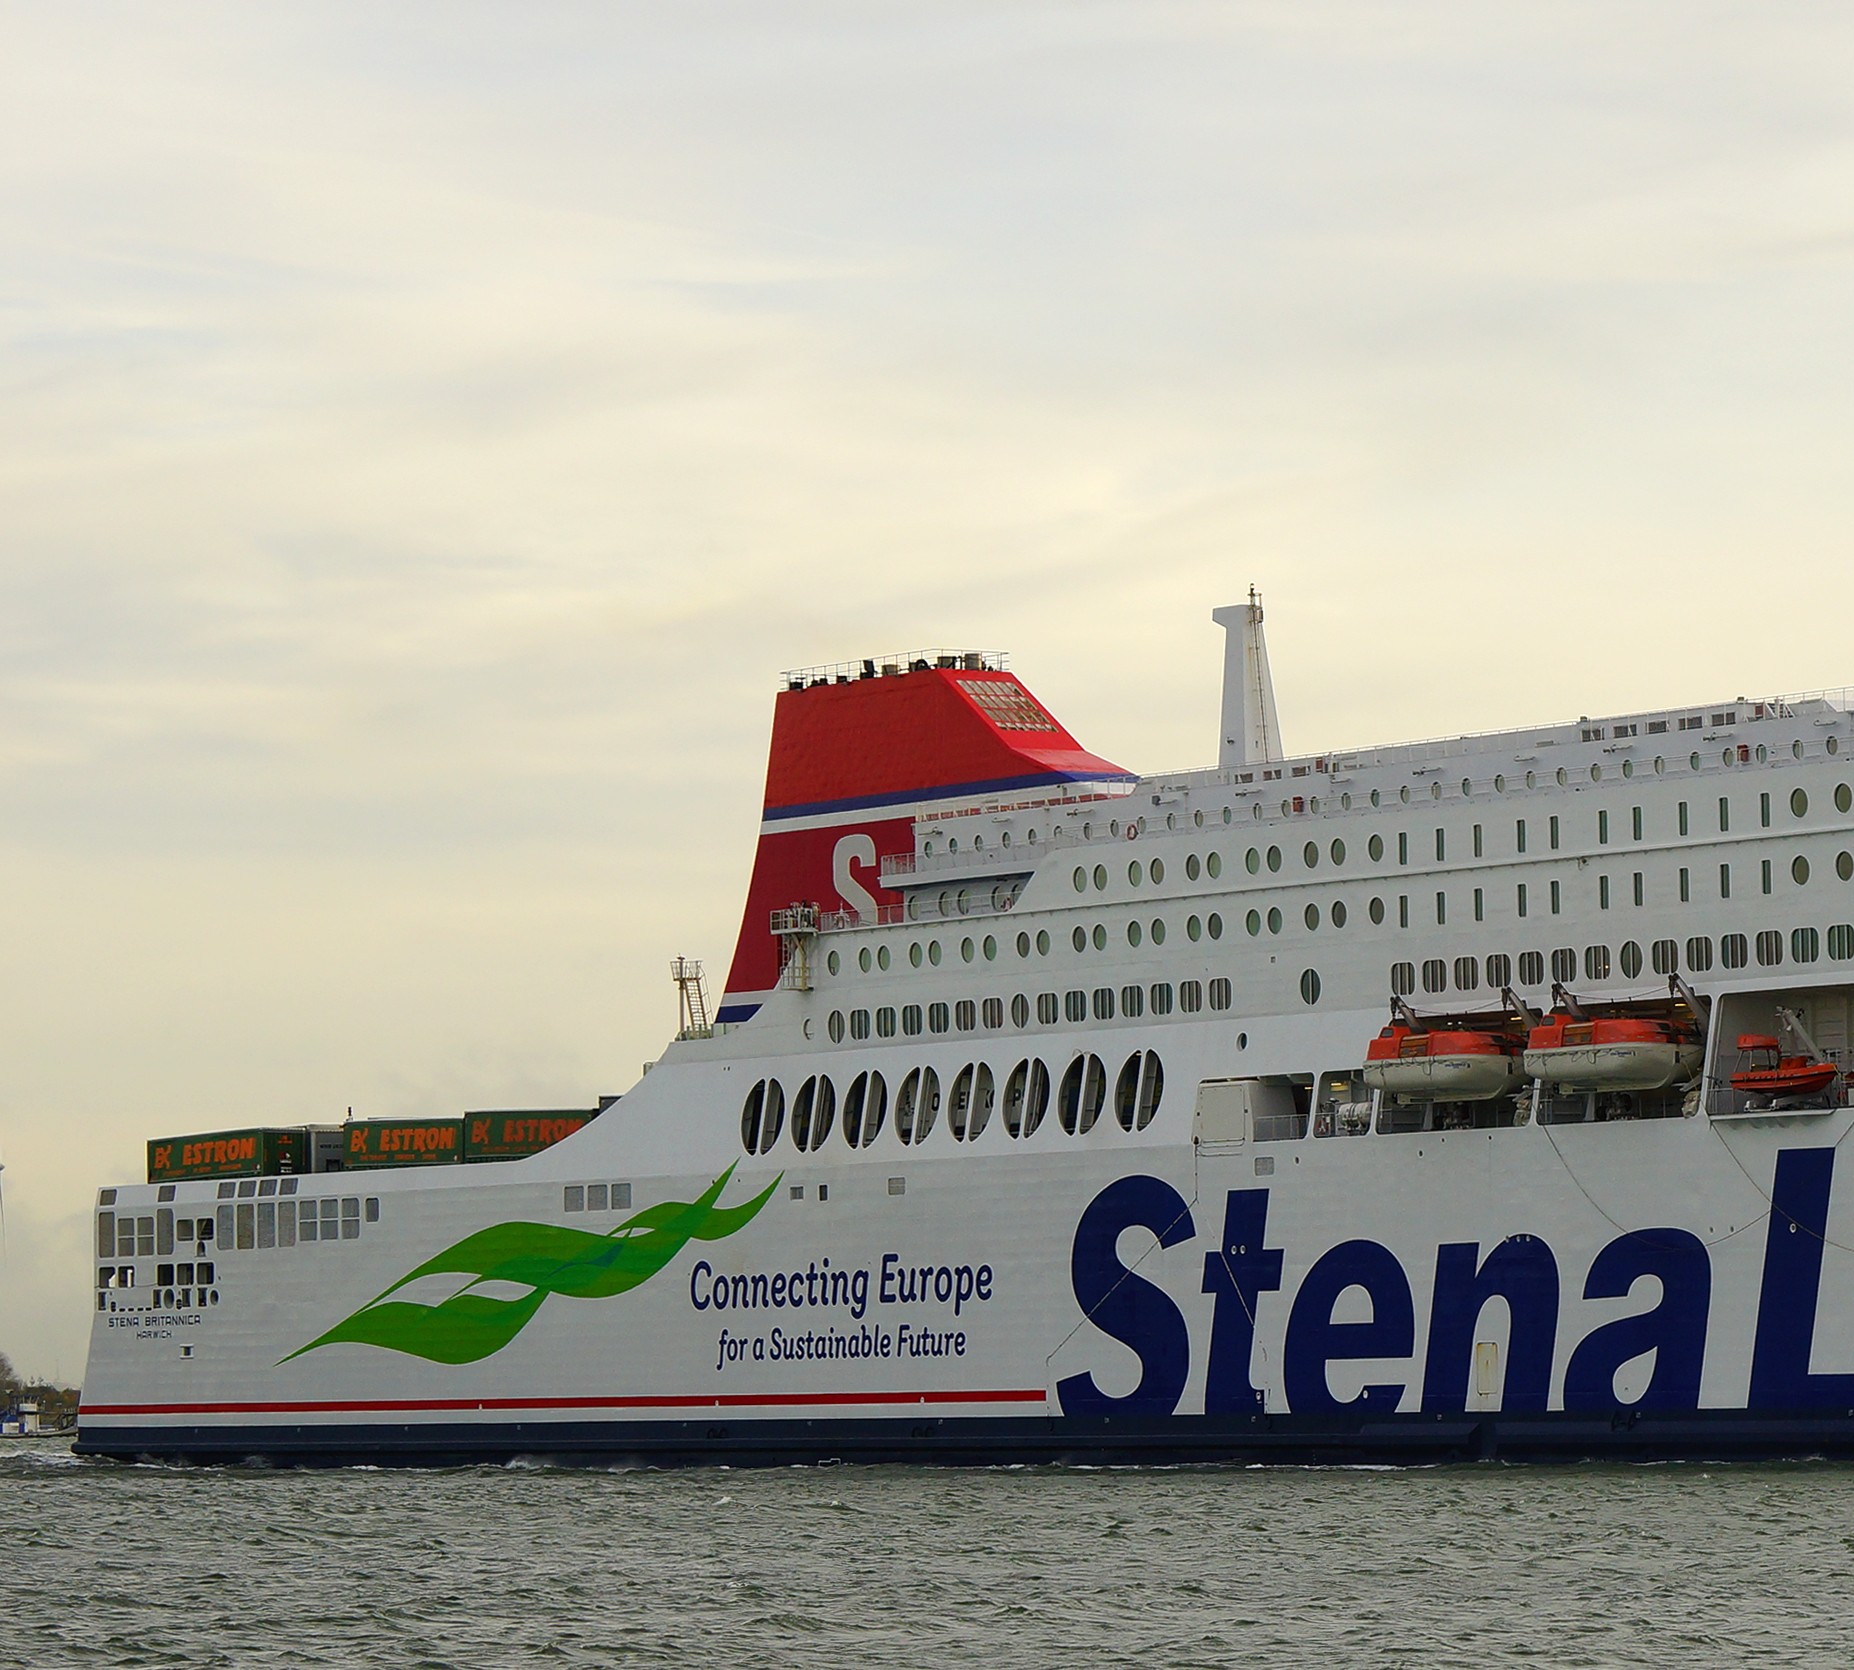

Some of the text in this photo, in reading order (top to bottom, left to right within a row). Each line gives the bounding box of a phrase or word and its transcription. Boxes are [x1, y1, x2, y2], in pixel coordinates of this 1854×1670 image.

[182, 1137, 256, 1165] ESTRON
[379, 1127, 456, 1152] ESTRON
[690, 1253, 993, 1319] Connecting Europe
[1055, 1173, 1713, 1415] Stena
[108, 1315, 201, 1328] STENA BRITANNICA
[136, 1330, 172, 1340] HARWICH
[716, 1324, 966, 1371] for a Sustainable Future
